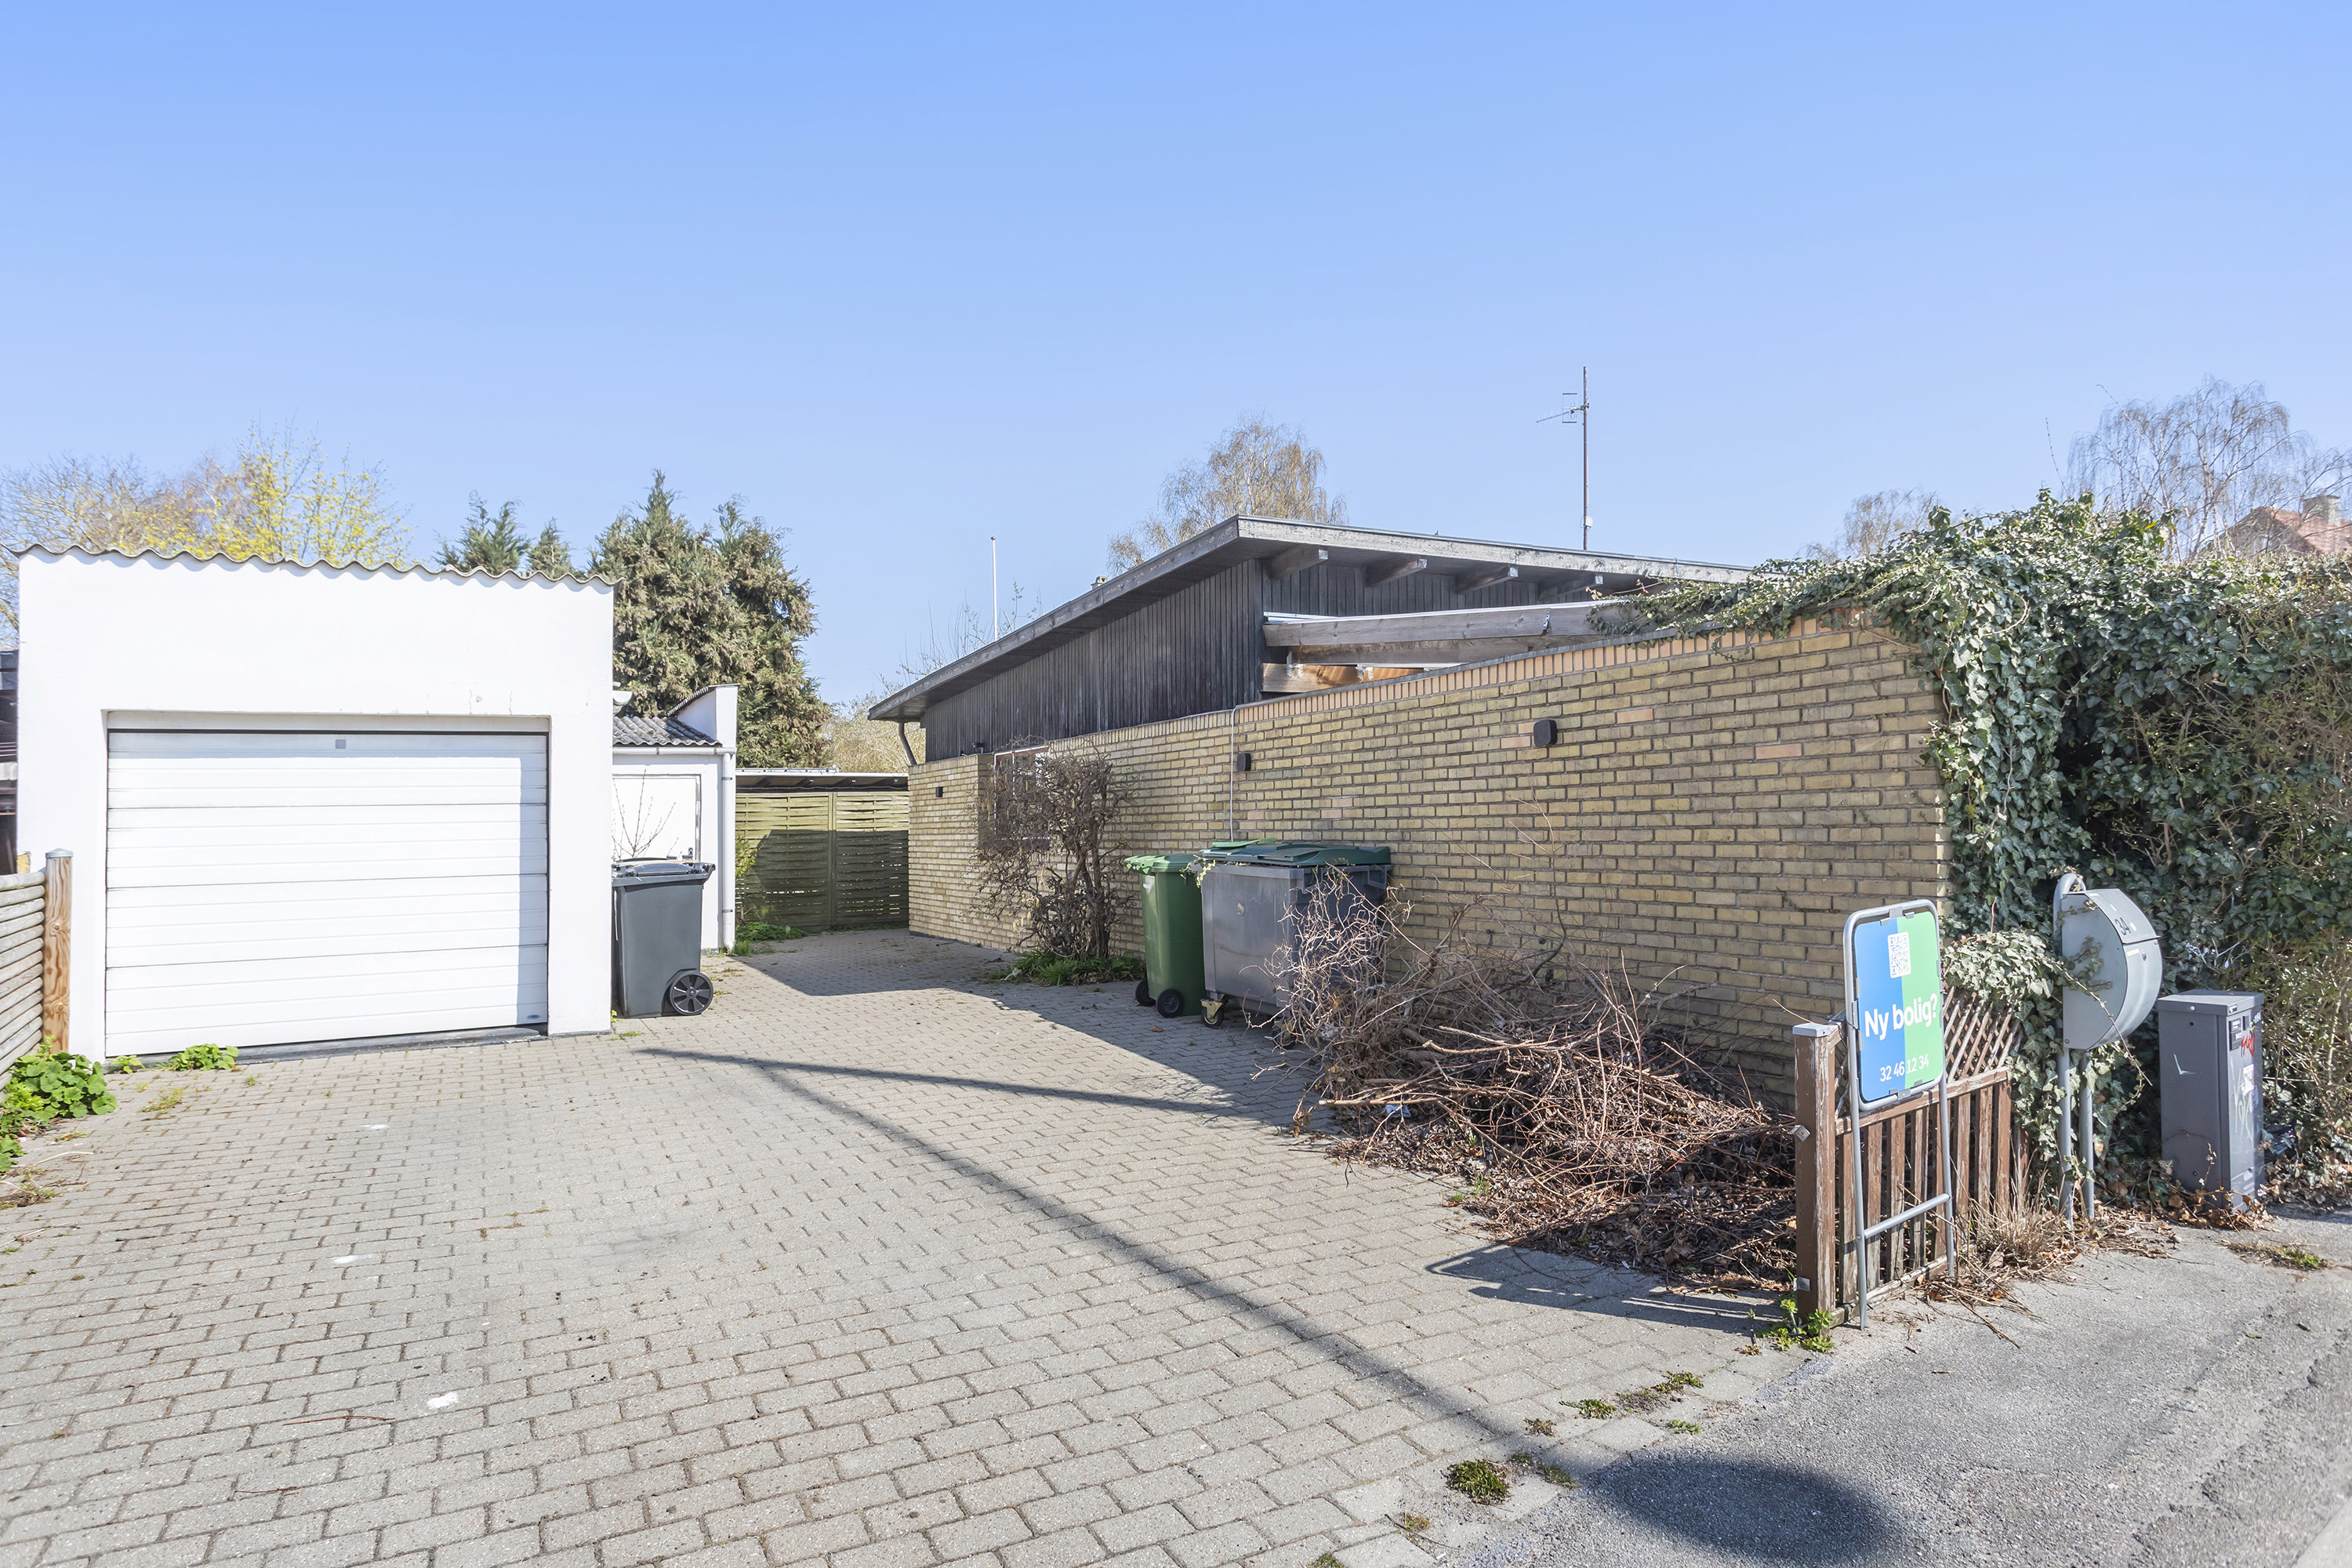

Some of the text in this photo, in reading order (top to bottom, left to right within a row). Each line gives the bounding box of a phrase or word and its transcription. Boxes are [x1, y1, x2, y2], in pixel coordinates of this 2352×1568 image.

[2114, 916, 2132, 936] 34
[1864, 993, 1938, 1041] Ny bolig?
[1879, 1053, 1929, 1082] 32 46 12 34
